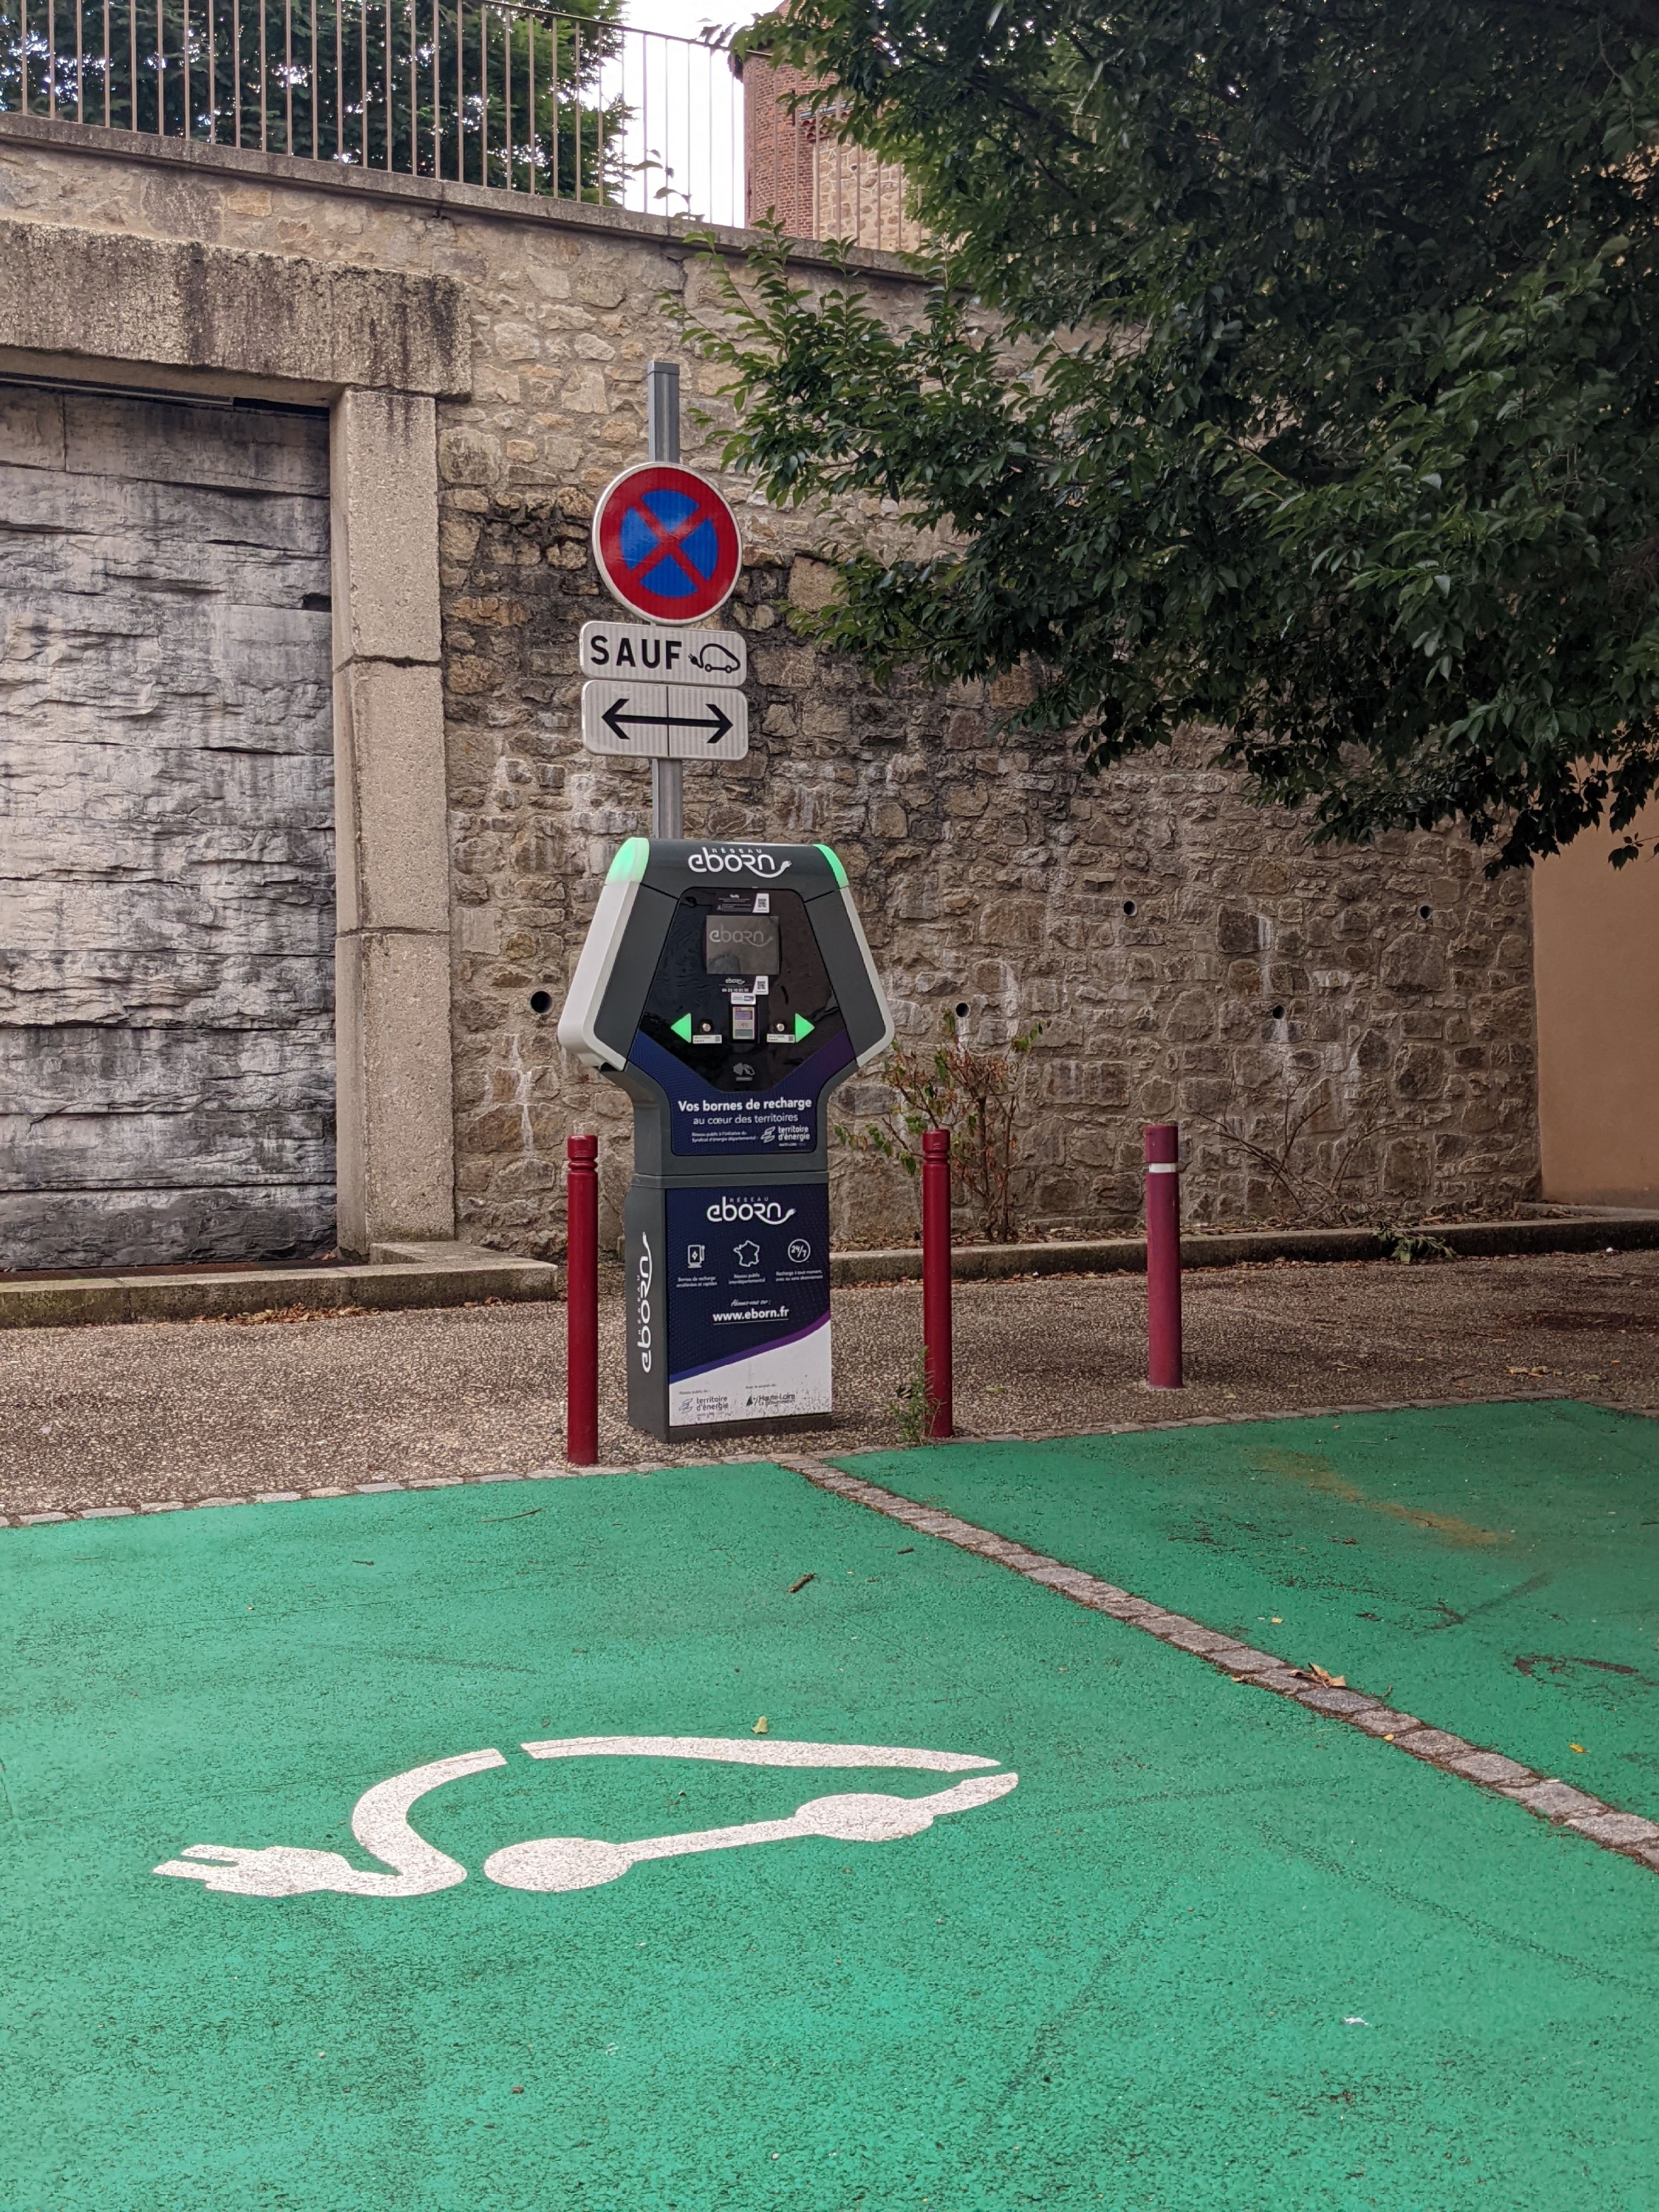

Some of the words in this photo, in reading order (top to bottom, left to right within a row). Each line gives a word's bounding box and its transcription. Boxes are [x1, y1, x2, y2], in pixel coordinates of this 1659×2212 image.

[590, 635, 682, 670] SAUF
[678, 1101, 699, 1111] Vos
[703, 1100, 743, 1111] bornes
[746, 1098, 760, 1110] de
[764, 1097, 812, 1110] recharge
[735, 1114, 752, 1124] des
[754, 1113, 798, 1123] territoires
[778, 1125, 809, 1133] territoire
[778, 1132, 810, 1142] d'énergie
[791, 1245, 807, 1257] 24/7
[713, 1305, 790, 1322] www.eborn.fr
[696, 1396, 728, 1404] territoire
[696, 1403, 729, 1411] d'énergie
